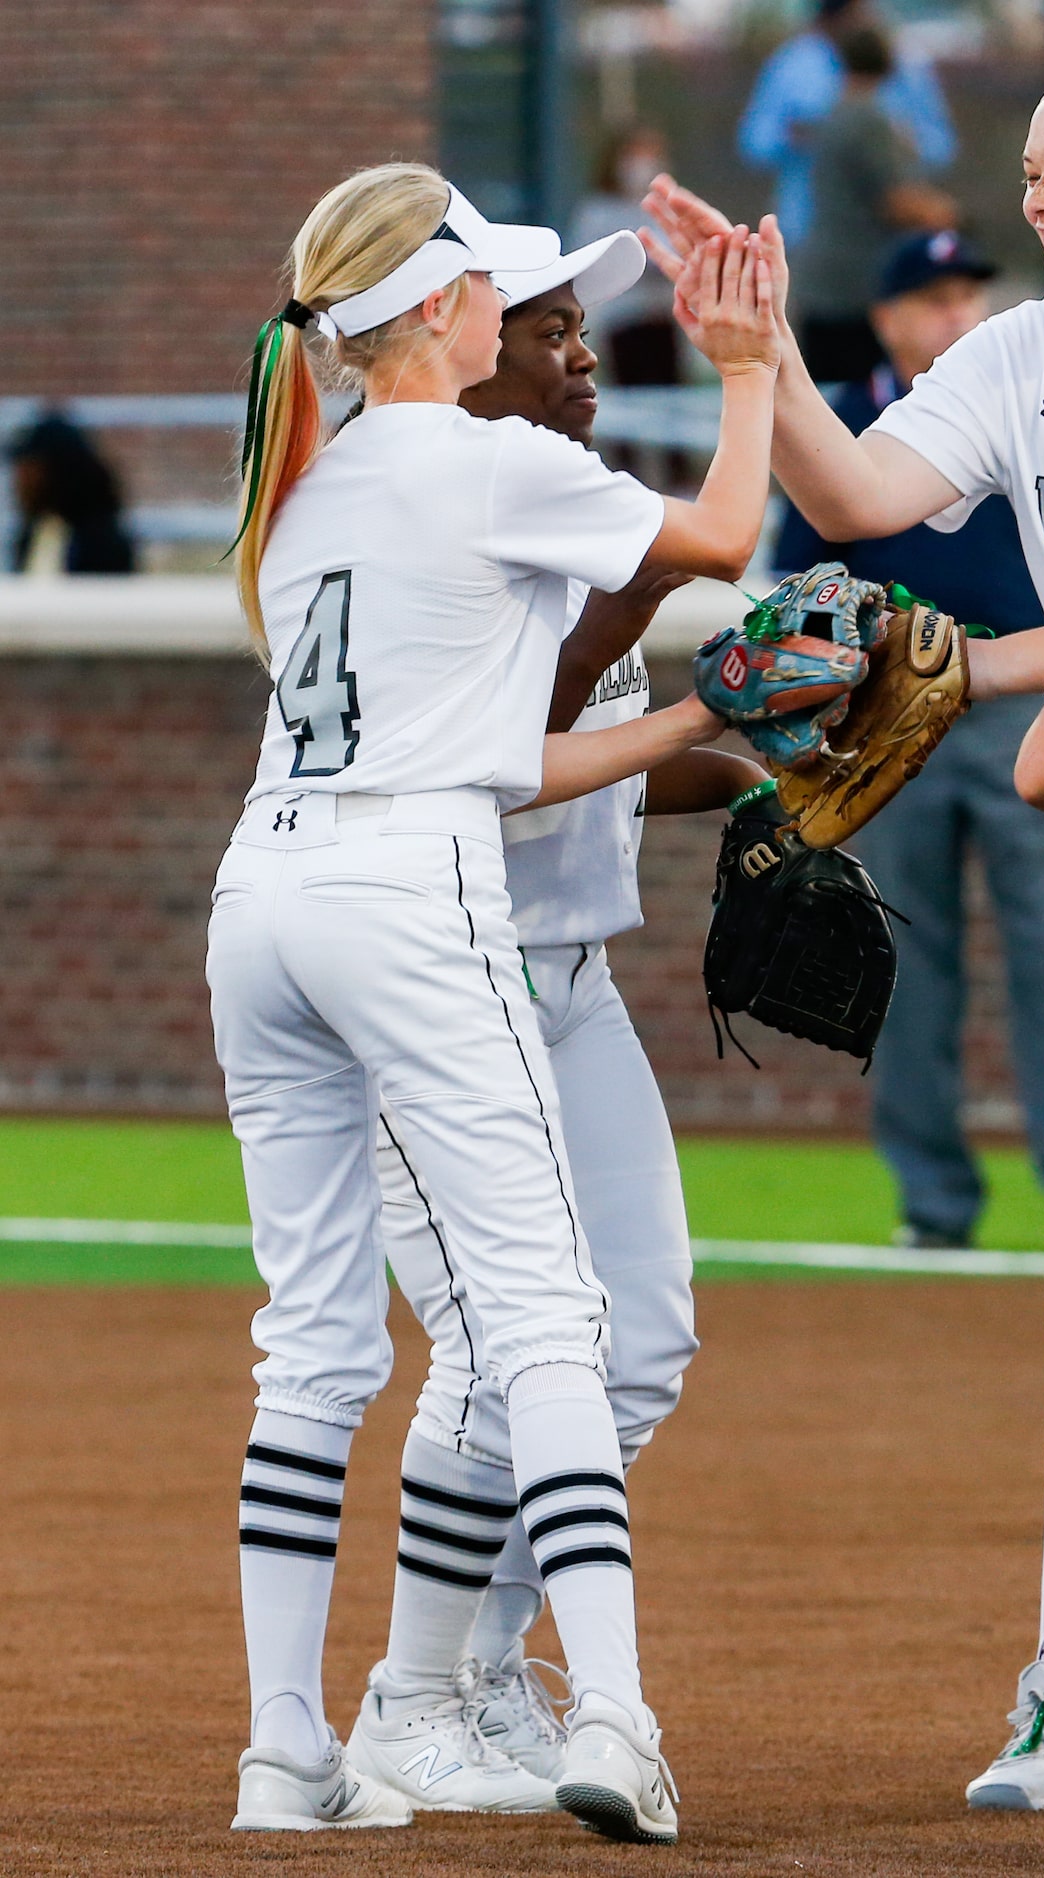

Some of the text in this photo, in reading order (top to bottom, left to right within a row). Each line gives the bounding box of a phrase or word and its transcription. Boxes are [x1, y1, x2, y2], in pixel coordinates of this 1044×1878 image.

[277, 569, 361, 778] 4
[397, 1743, 463, 1792] N
[321, 1772, 361, 1817] N
